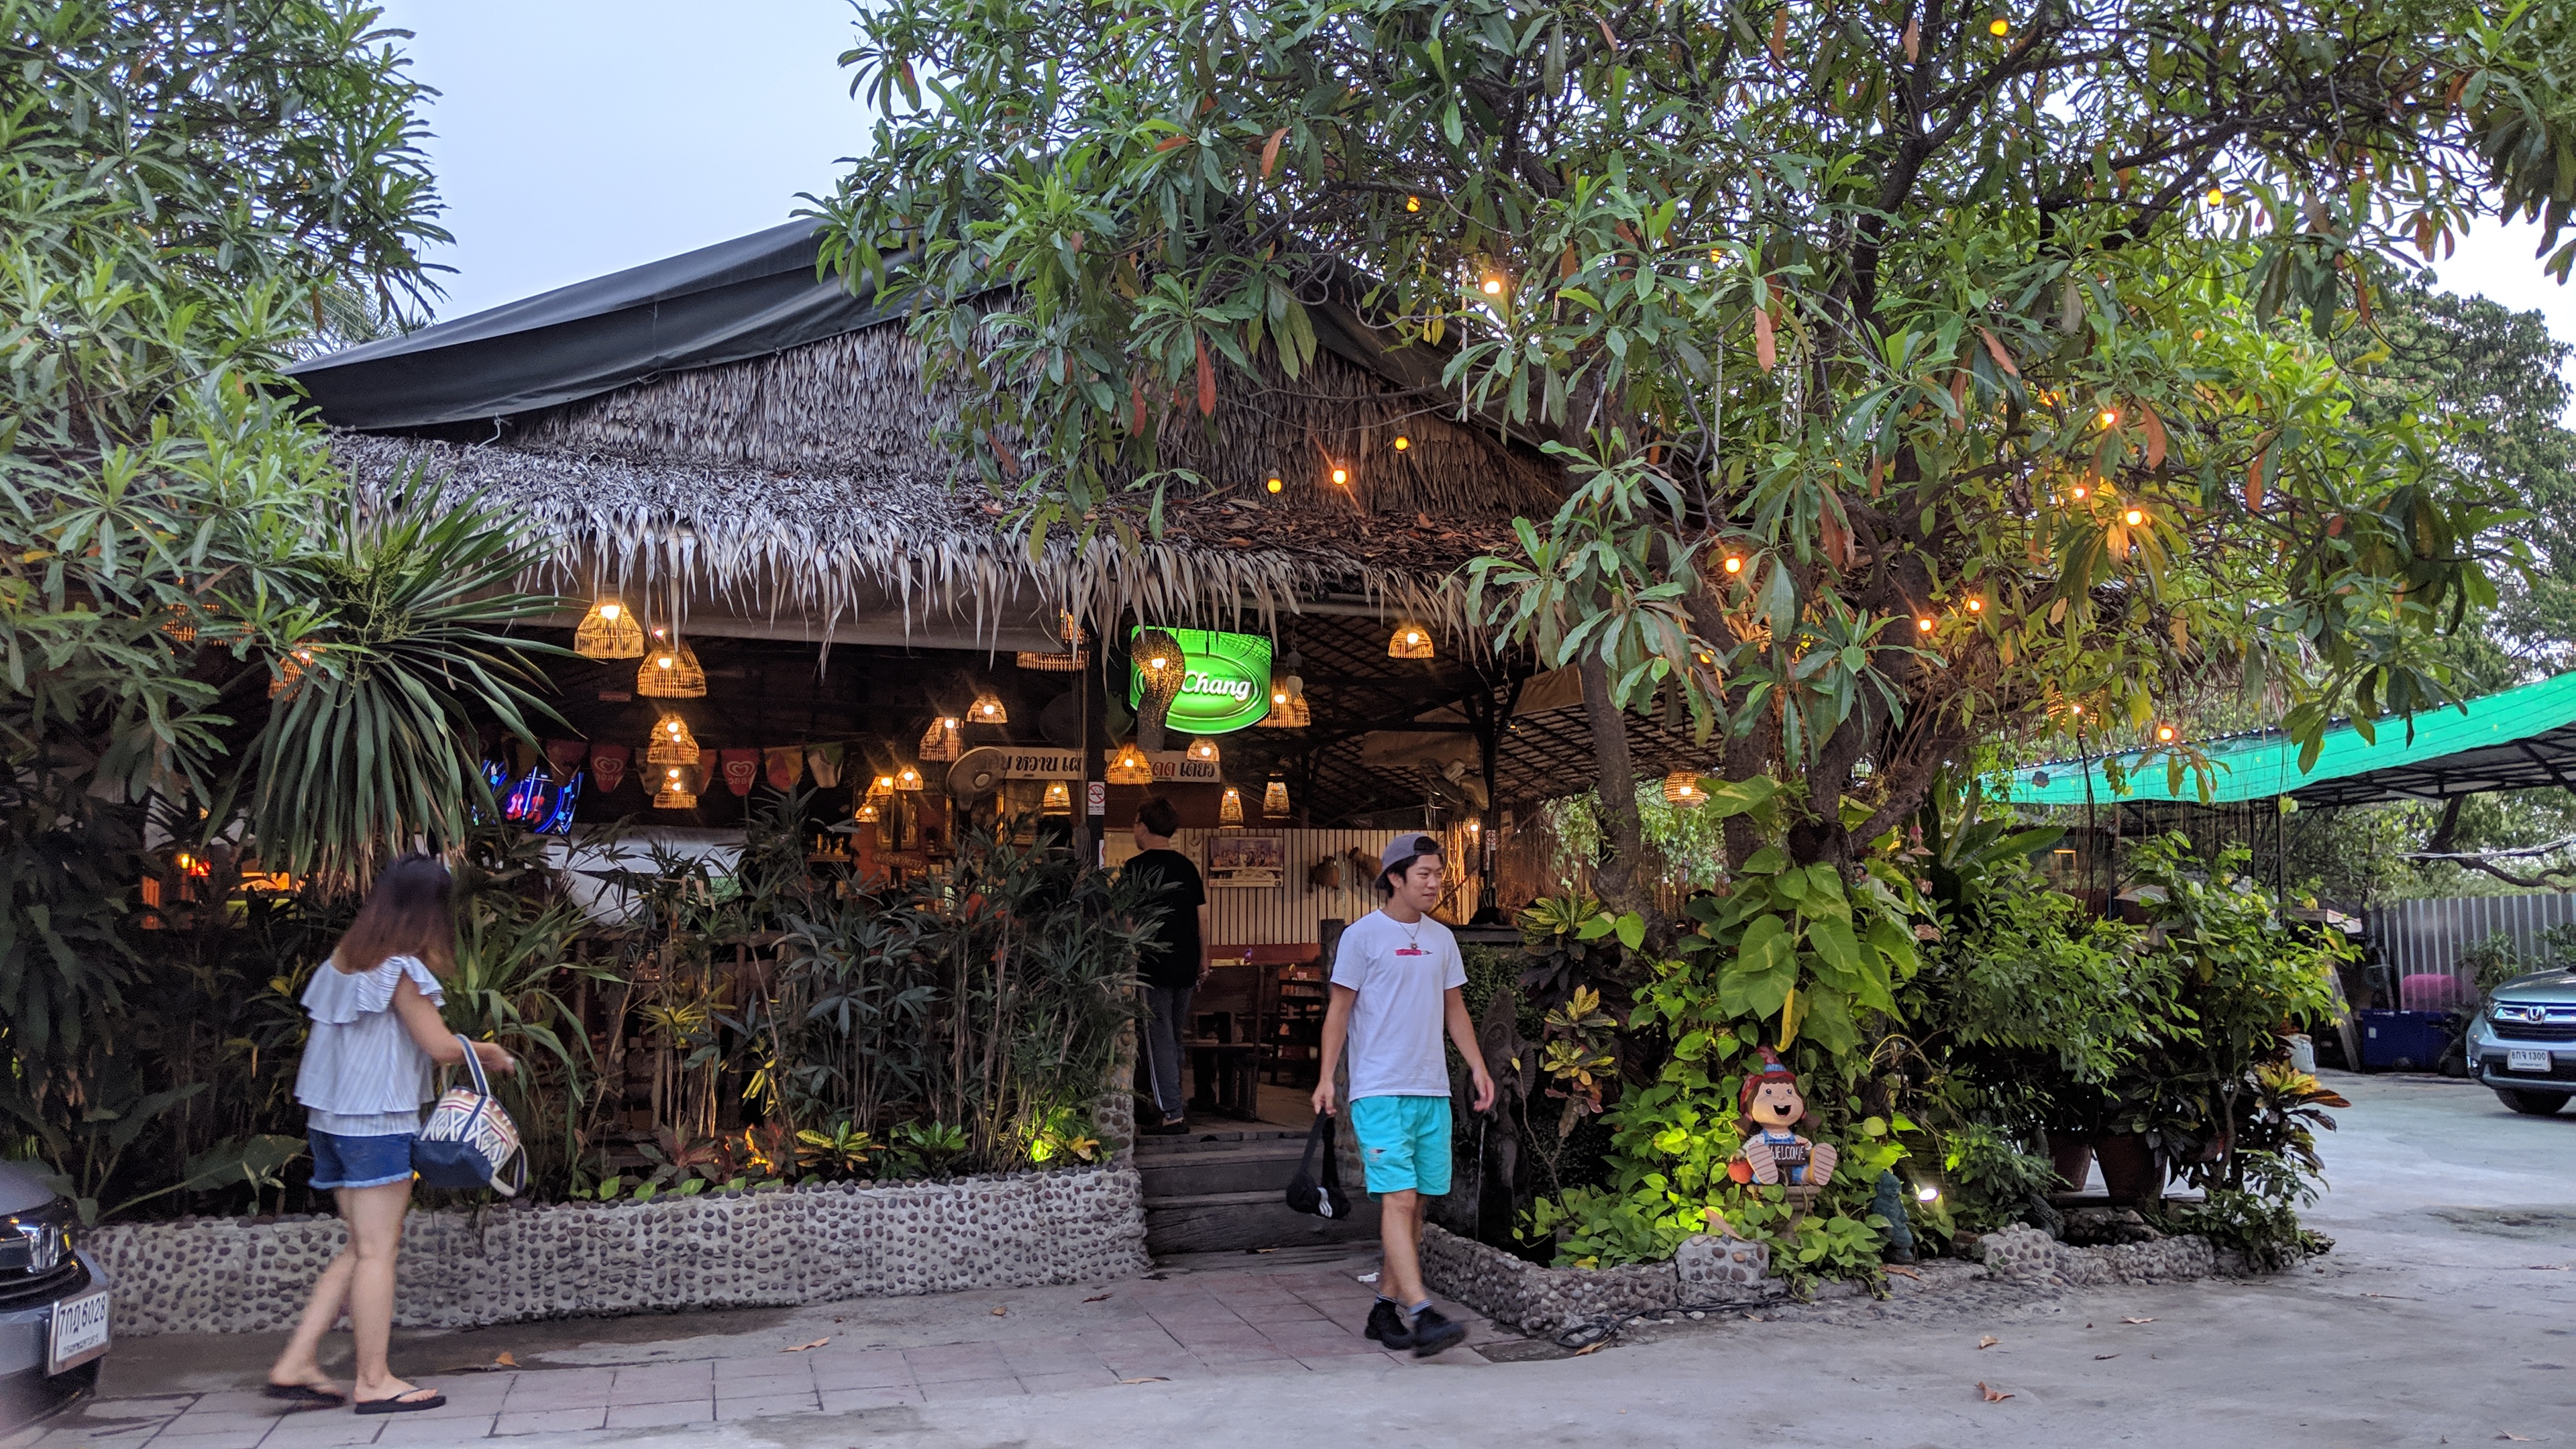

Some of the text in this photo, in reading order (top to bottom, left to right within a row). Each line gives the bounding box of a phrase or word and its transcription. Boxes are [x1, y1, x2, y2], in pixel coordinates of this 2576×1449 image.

[1181, 670, 1252, 702] Chang
[1015, 755, 1059, 771] หวาน
[1148, 761, 1176, 777] ดด
[2528, 1052, 2546, 1061] 1300
[1770, 1145, 1805, 1161] WELCOME
[82, 1295, 106, 1328] 6028
